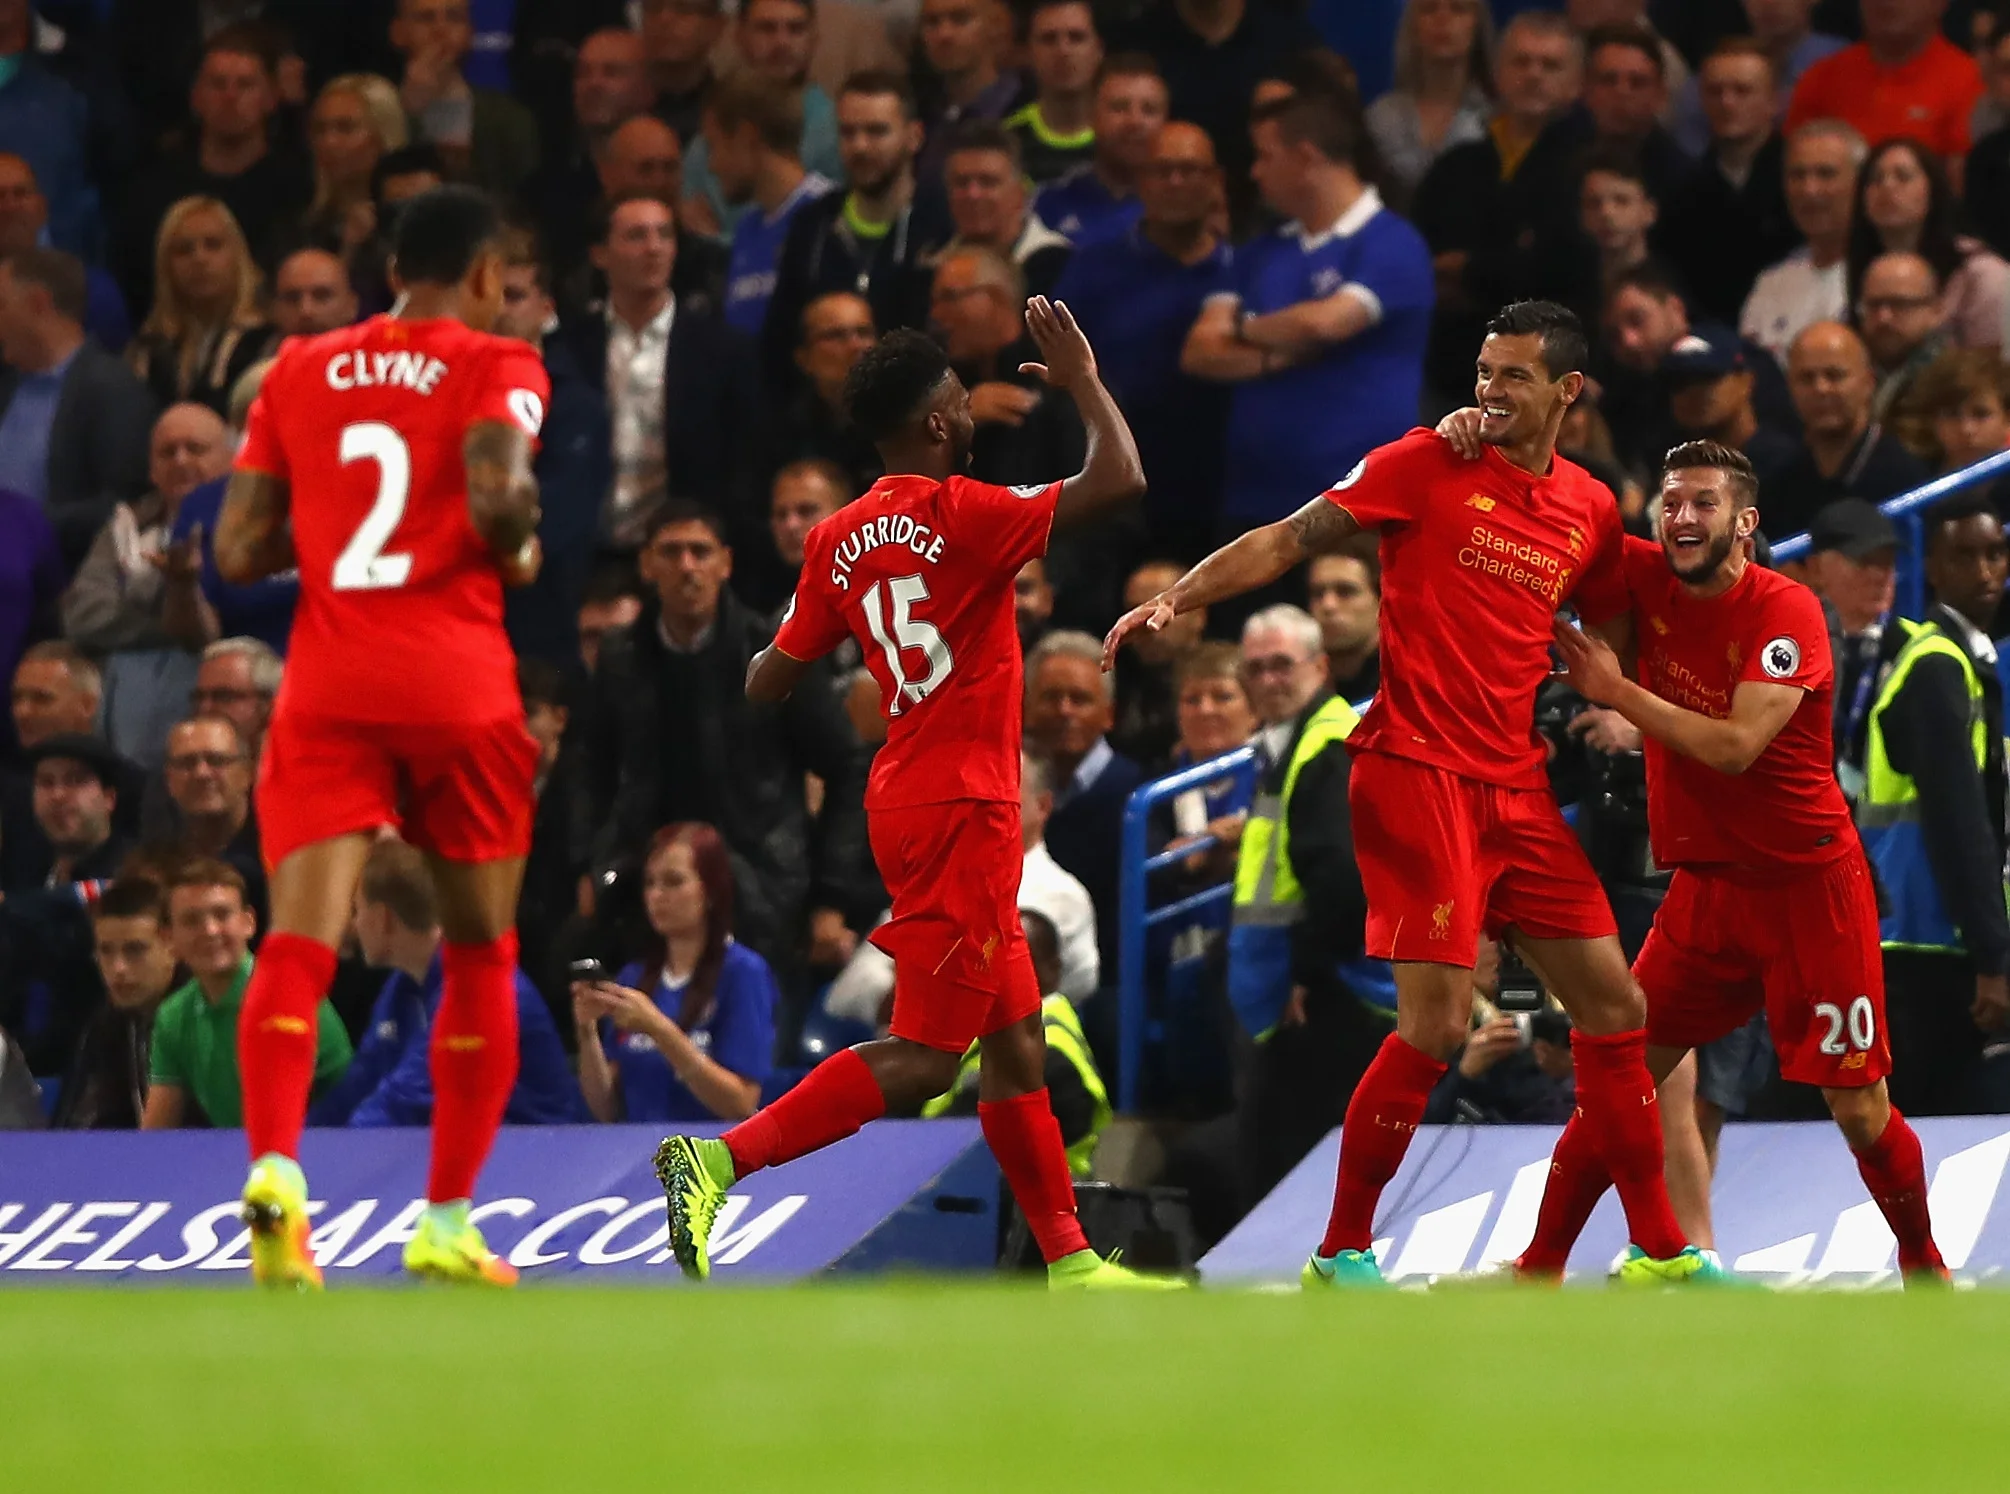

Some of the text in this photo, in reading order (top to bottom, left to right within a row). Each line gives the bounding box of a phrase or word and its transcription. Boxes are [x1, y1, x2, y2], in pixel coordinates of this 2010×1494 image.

[325, 349, 449, 397] CLYNE
[332, 419, 414, 592] 2
[831, 514, 945, 591] STURRIDGE
[1458, 547, 1553, 597] Chartered
[1470, 526, 1559, 575] Standard
[860, 572, 955, 717] 15
[1814, 994, 1876, 1055] 20
